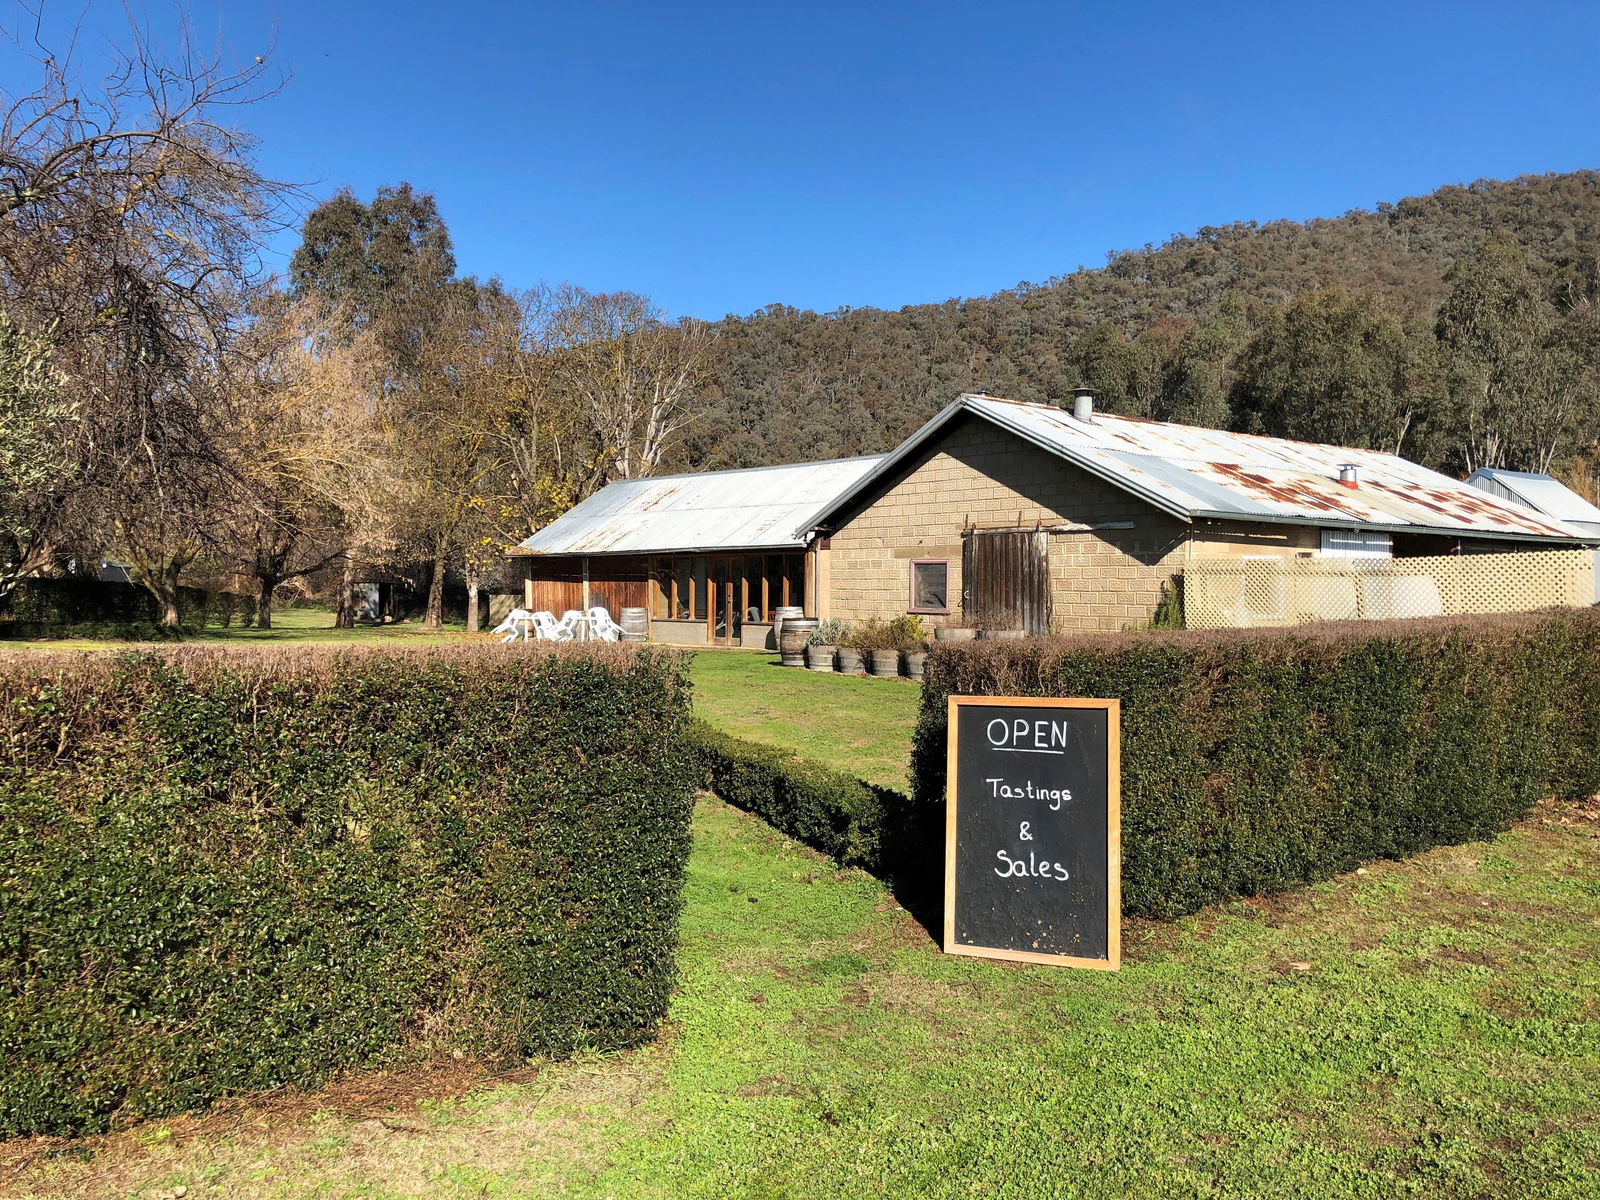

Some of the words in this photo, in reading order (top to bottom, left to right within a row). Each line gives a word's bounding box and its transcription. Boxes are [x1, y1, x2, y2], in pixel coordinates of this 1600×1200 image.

[986, 718, 1067, 748] OPEN
[985, 778, 1072, 810] Tastings
[1019, 821, 1033, 841] &
[994, 849, 1069, 881] Sales
